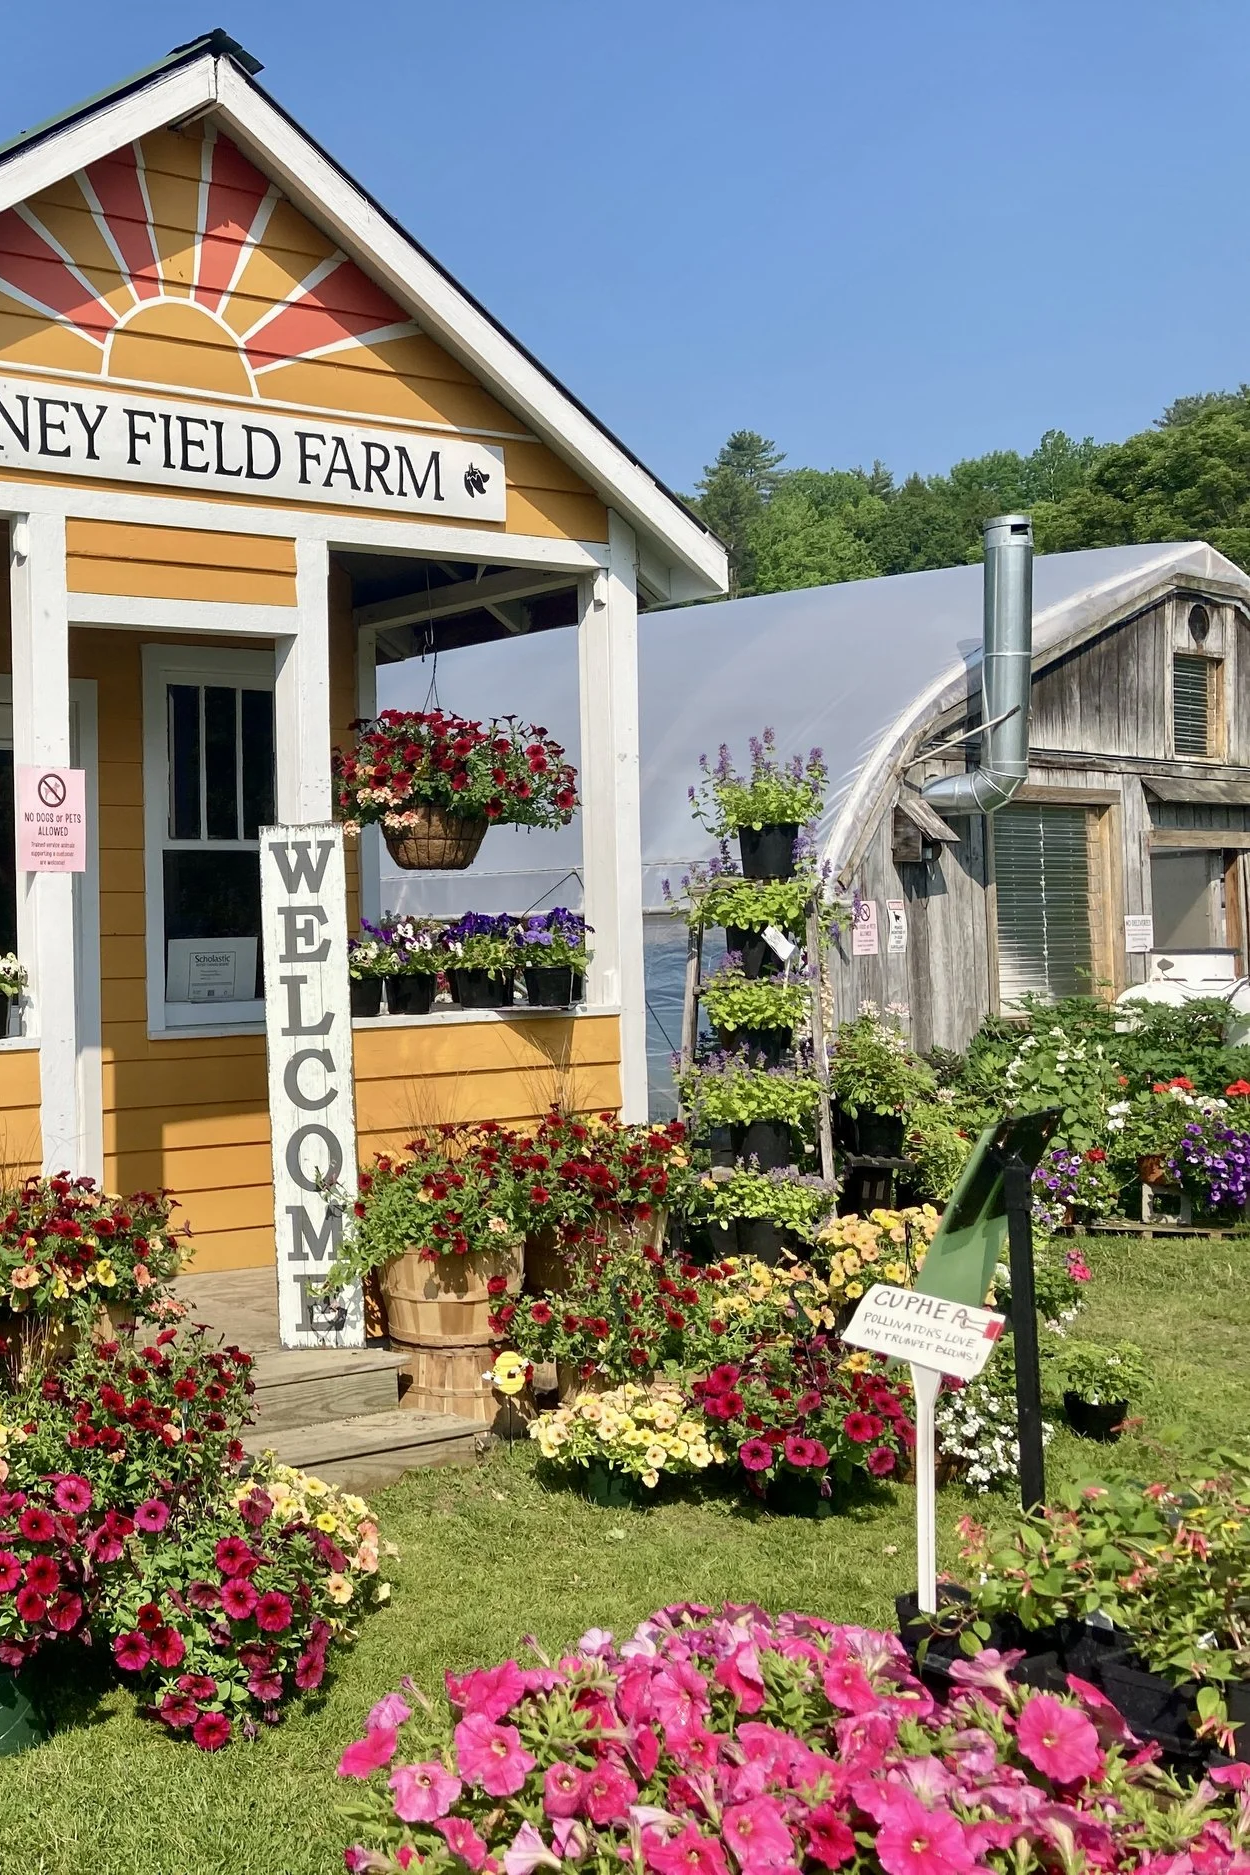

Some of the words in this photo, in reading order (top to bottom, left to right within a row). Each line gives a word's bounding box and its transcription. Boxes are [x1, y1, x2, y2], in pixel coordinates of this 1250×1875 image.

[121, 408, 281, 480] FIELD
[297, 431, 445, 502] FARM
[24, 812, 34, 822] NO
[36, 812, 54, 823] DOGS
[56, 815, 63, 823] or
[65, 813, 81, 824] PETS
[38, 826, 69, 837] ALLOWED
[195, 954, 231, 963] Scholastic
[269, 840, 350, 1332] WELCOME
[874, 1290, 967, 1324] CUPHEA
[864, 1327, 881, 1340] MY
[885, 1332, 934, 1351] TRUMPET
[945, 1332, 977, 1349] LOVE
